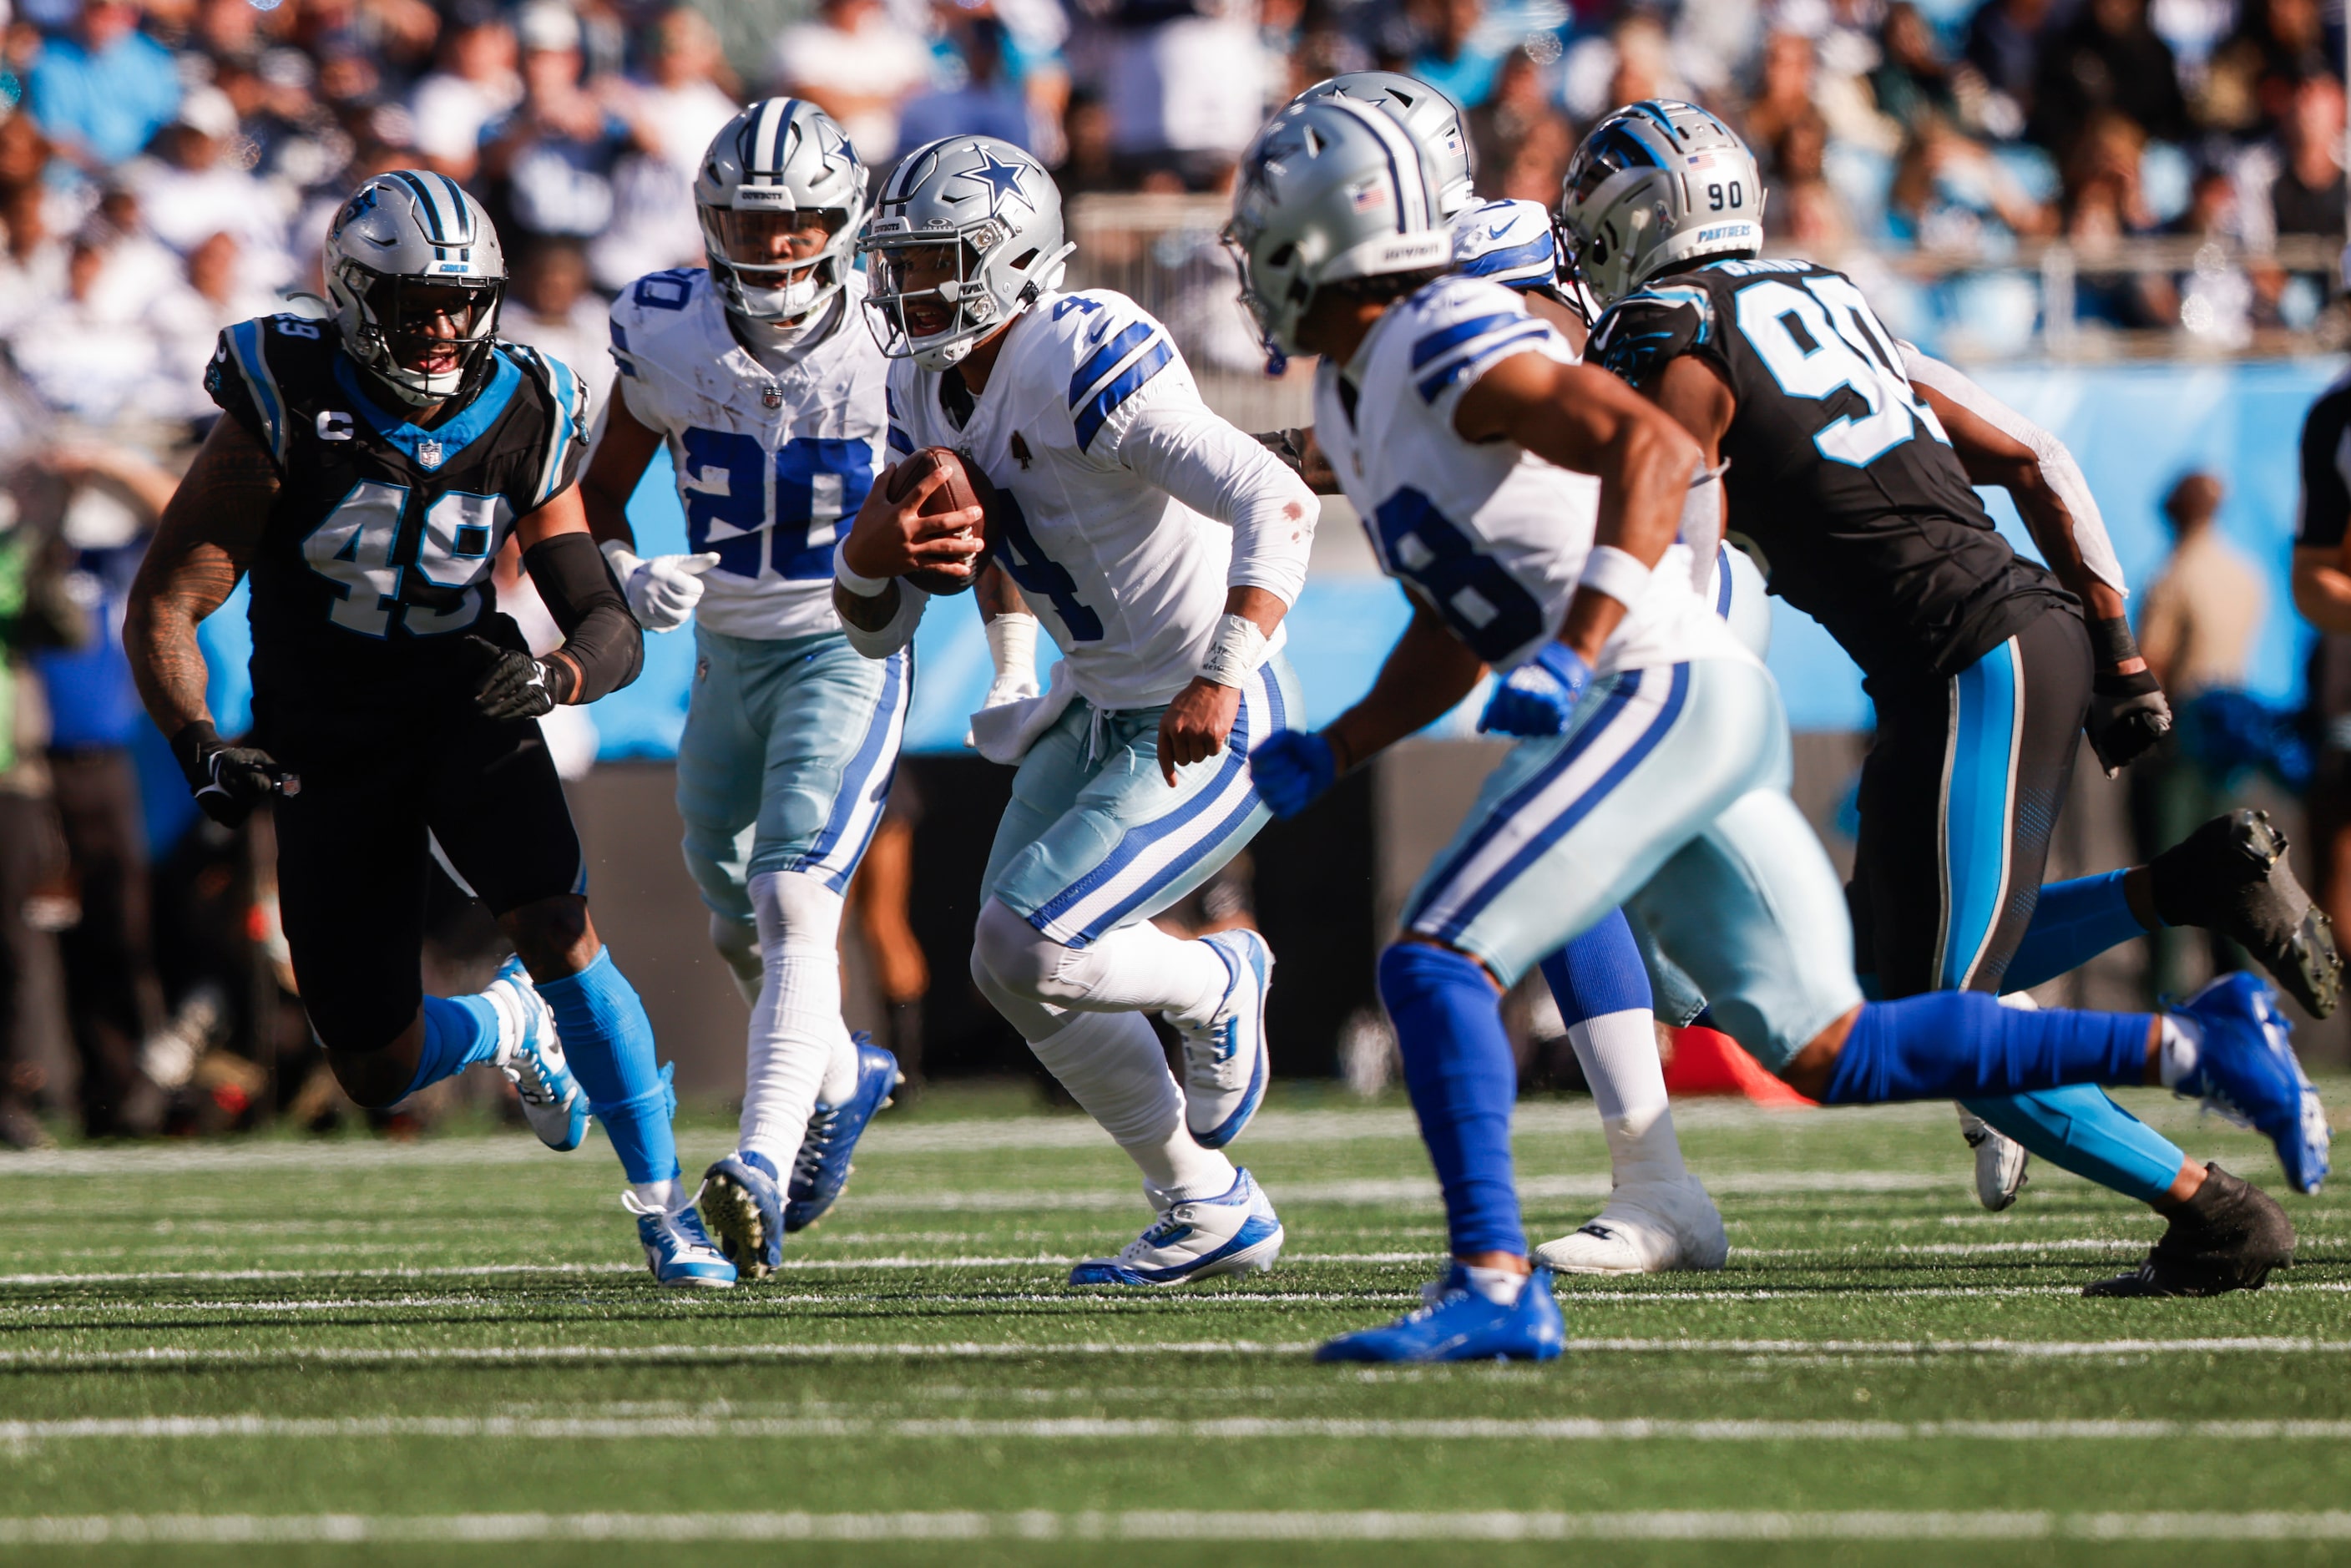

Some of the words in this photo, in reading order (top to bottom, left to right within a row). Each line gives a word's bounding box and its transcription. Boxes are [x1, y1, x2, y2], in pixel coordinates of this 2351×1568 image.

[741, 191, 782, 200] COWBOYS
[1708, 180, 1742, 210] 90
[1052, 296, 1105, 321] 4
[1735, 275, 1954, 469] 90
[316, 411, 355, 441] C
[680, 426, 874, 579] 20
[301, 478, 518, 641] 49
[992, 488, 1105, 641] 4
